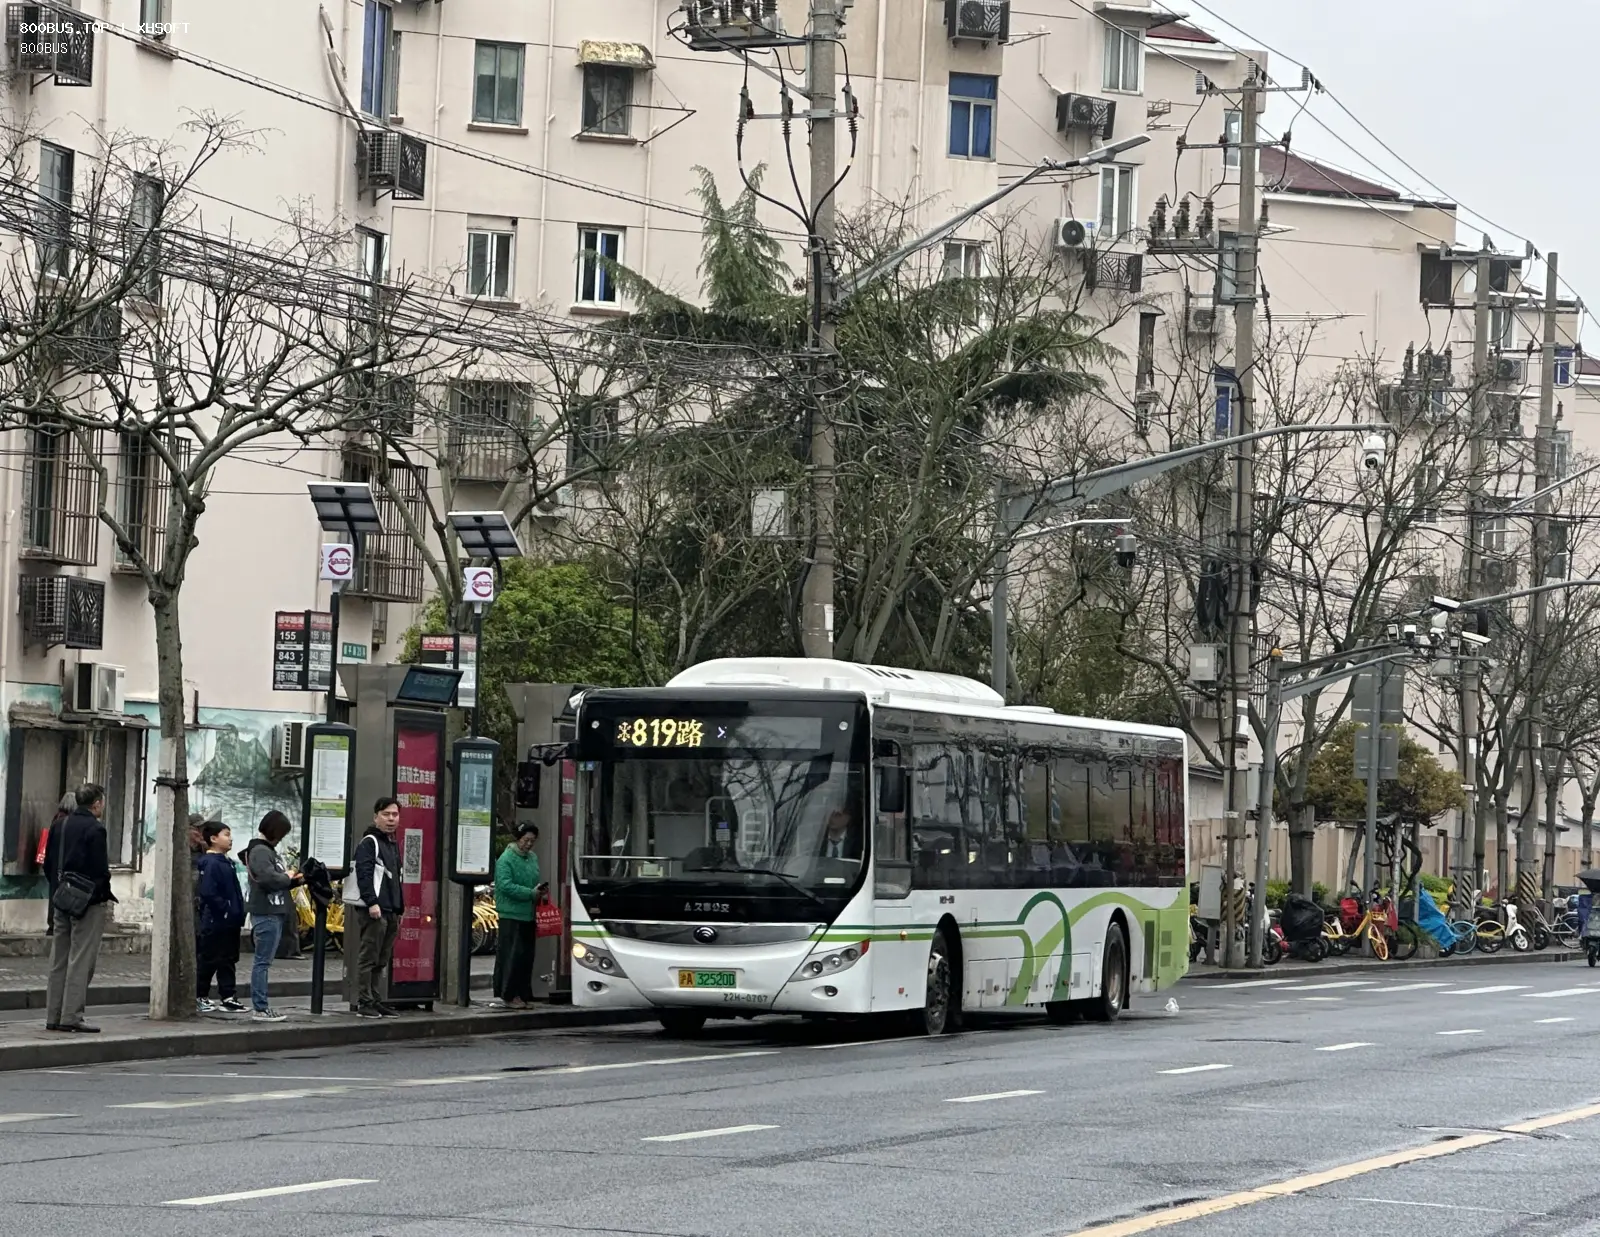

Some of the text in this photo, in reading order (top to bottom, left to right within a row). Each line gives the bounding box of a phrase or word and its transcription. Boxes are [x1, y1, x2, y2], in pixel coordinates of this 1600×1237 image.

[279, 631, 296, 640] 155
[278, 651, 295, 661] 843
[631, 718, 705, 747] 819路
